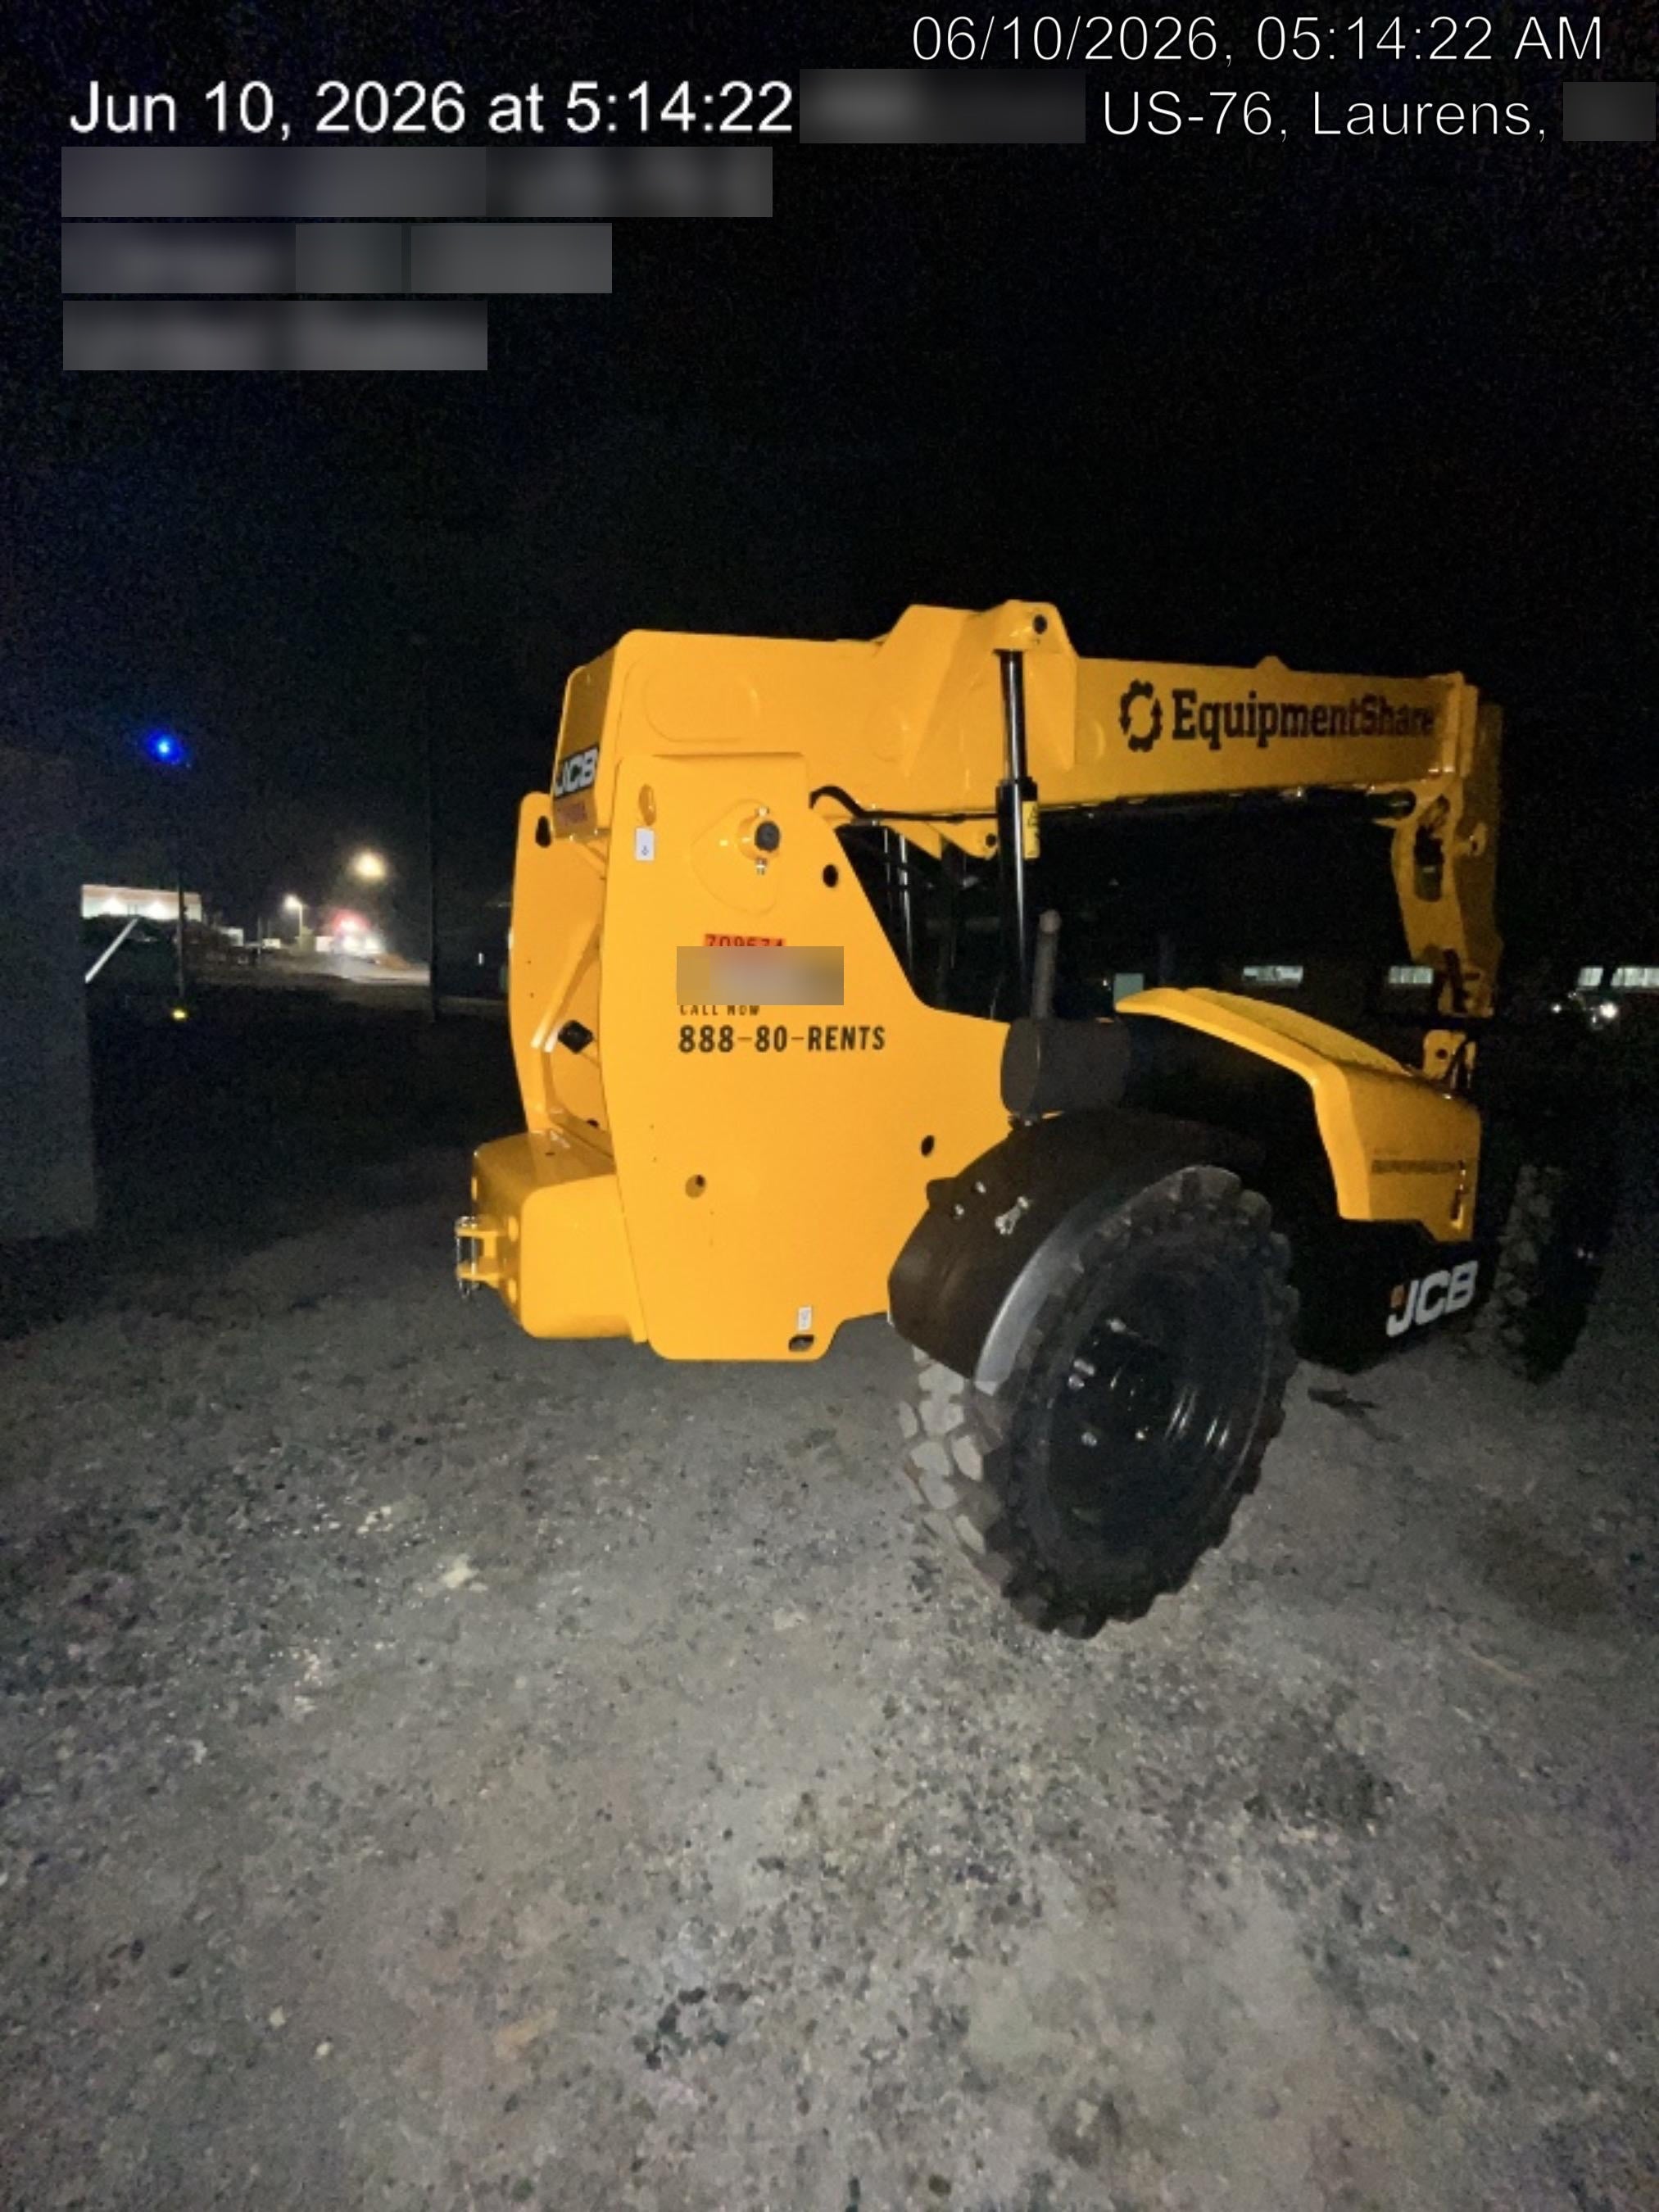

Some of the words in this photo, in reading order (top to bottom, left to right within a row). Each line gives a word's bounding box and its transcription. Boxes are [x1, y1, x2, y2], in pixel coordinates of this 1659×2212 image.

[1172, 689, 1436, 750] EquipmentShare
[555, 747, 597, 797] JCB
[679, 1005, 718, 1016] CALL
[679, 1024, 886, 1053] 888-80-RENTS
[1386, 1260, 1478, 1337] JCB
